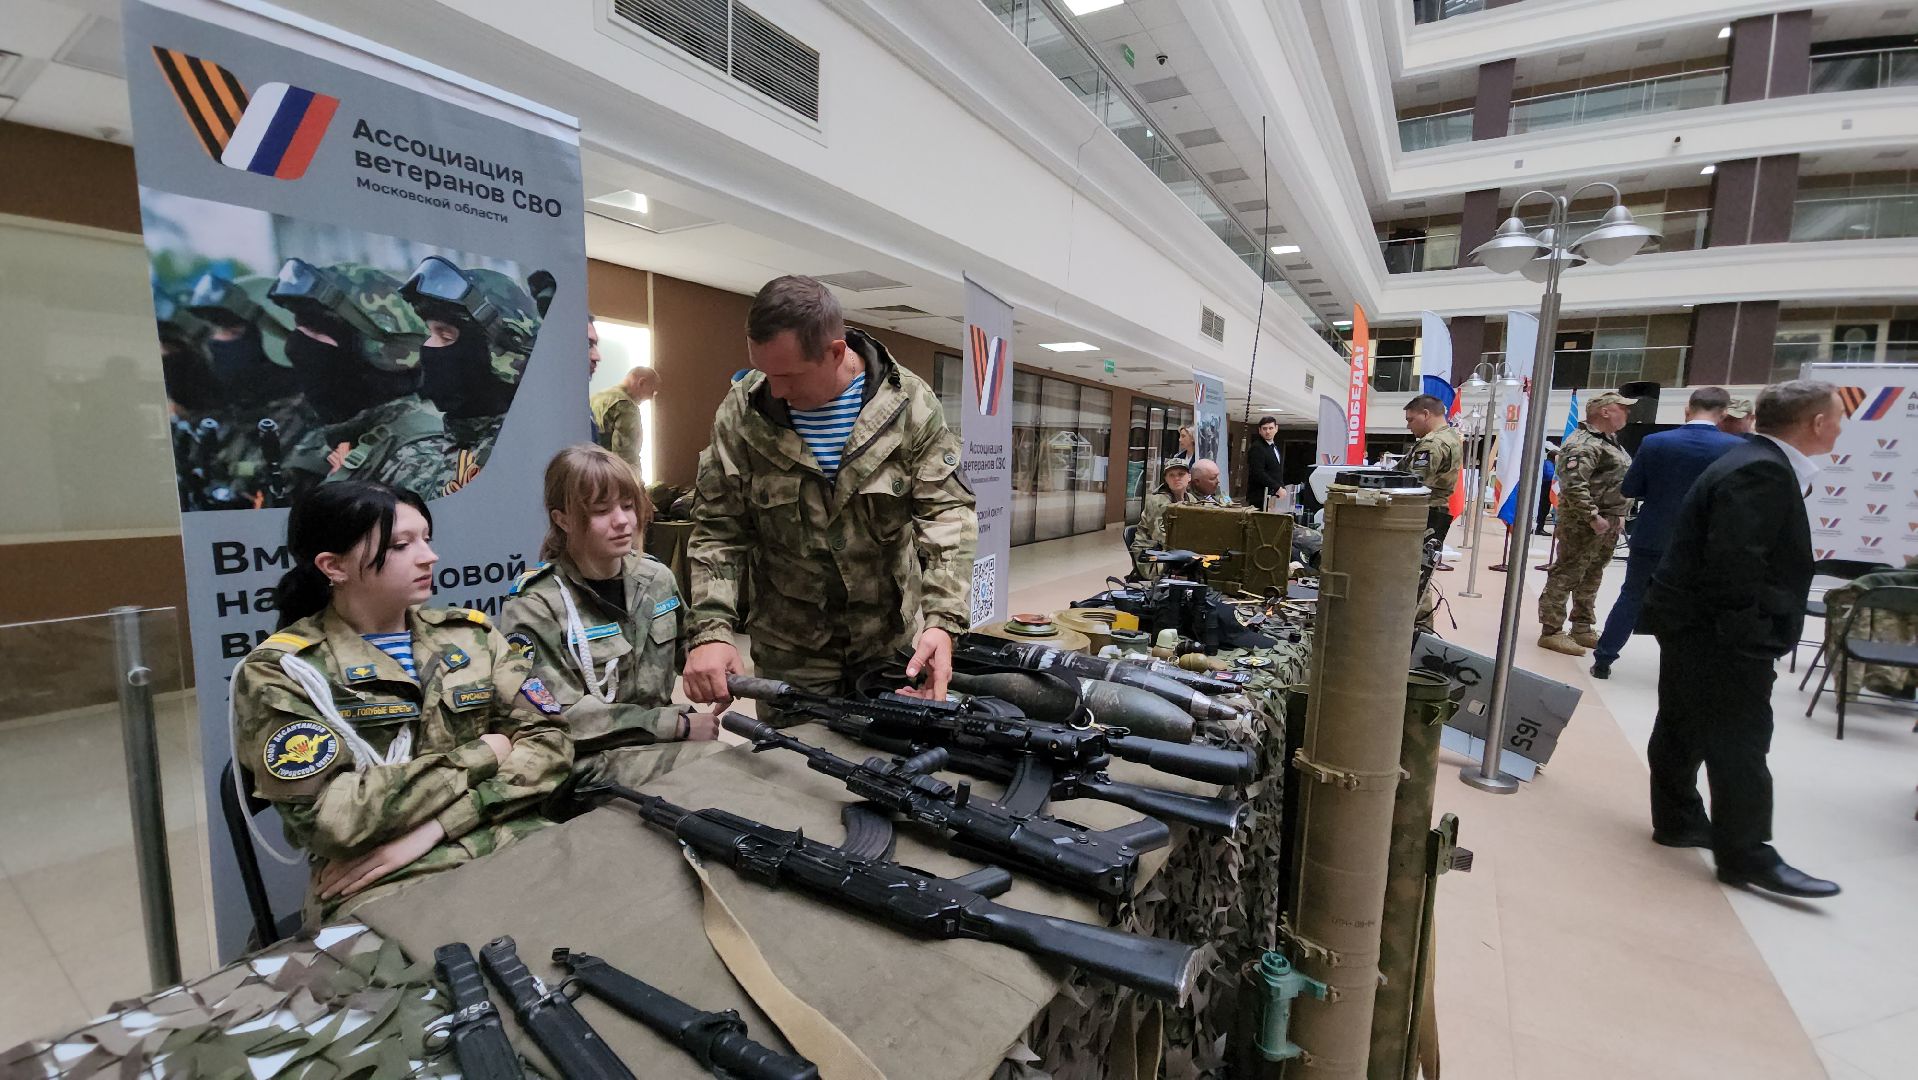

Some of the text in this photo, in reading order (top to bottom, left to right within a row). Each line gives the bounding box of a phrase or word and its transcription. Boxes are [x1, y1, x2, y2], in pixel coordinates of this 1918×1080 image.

[353, 119, 523, 186] Ассоциация
[355, 150, 562, 218] ветеранов СВО
[356, 177, 508, 224] Московской области
[1348, 346, 1365, 445] ПОБЕДА!
[212, 541, 290, 576] Вм
